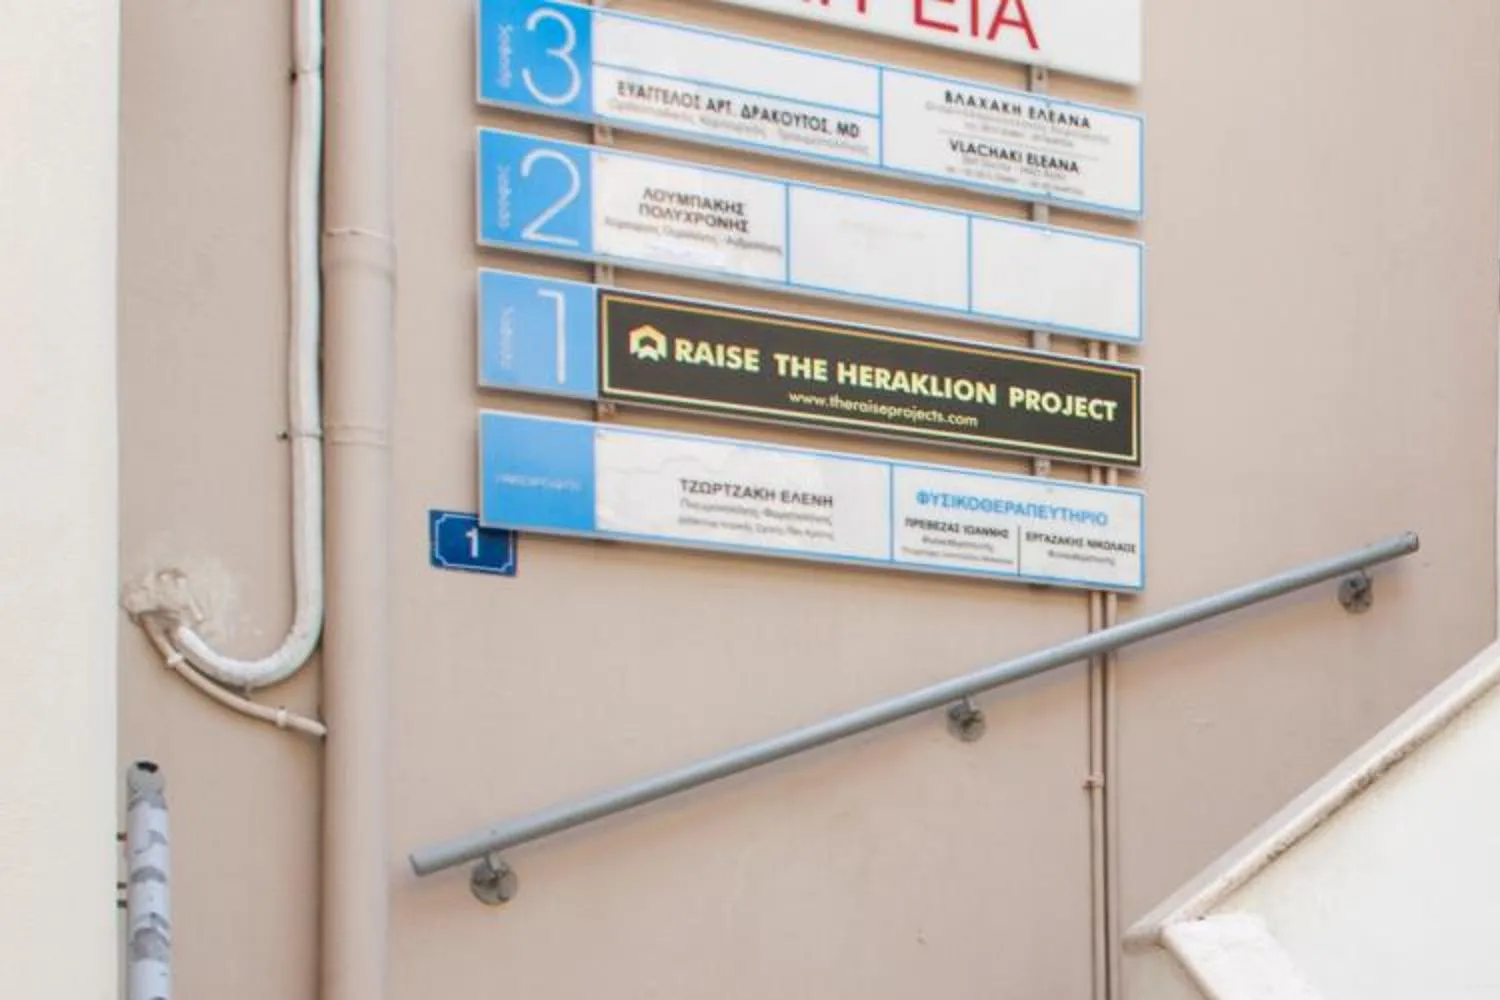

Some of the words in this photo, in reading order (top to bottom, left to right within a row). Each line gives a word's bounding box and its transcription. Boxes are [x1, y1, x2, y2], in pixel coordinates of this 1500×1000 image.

[522, 7, 582, 106] 3
[944, 90, 1023, 116] ΒΛΑΧΑΚΗ
[1028, 107, 1091, 129] ΕΛΕΑΝΑ
[949, 138, 1023, 163] VLACHAKI
[1026, 152, 1080, 174] ELEANA
[520, 148, 580, 247] 2
[643, 186, 745, 216] ΛΟΥΜΠΑΚΗΣ
[638, 202, 750, 233] ΠΟΛΥΧΡΟΝΗΣ
[537, 287, 566, 385] 1
[674, 336, 761, 373] RAISE
[773, 352, 829, 382] THE
[836, 361, 997, 406] HERAKLION
[1008, 385, 1119, 422] PROJECT
[788, 391, 978, 428] www.theraiseprojects.com
[680, 478, 776, 501] ΤΖΩΡΤΖΑΚΗ
[780, 490, 834, 508] ΕΛΕΝΗ
[915, 488, 1109, 527] ΦΥΣΙΚΟΘΕΡΑΠΕΥΤΗΡΙΟ
[465, 527, 479, 558] 1
